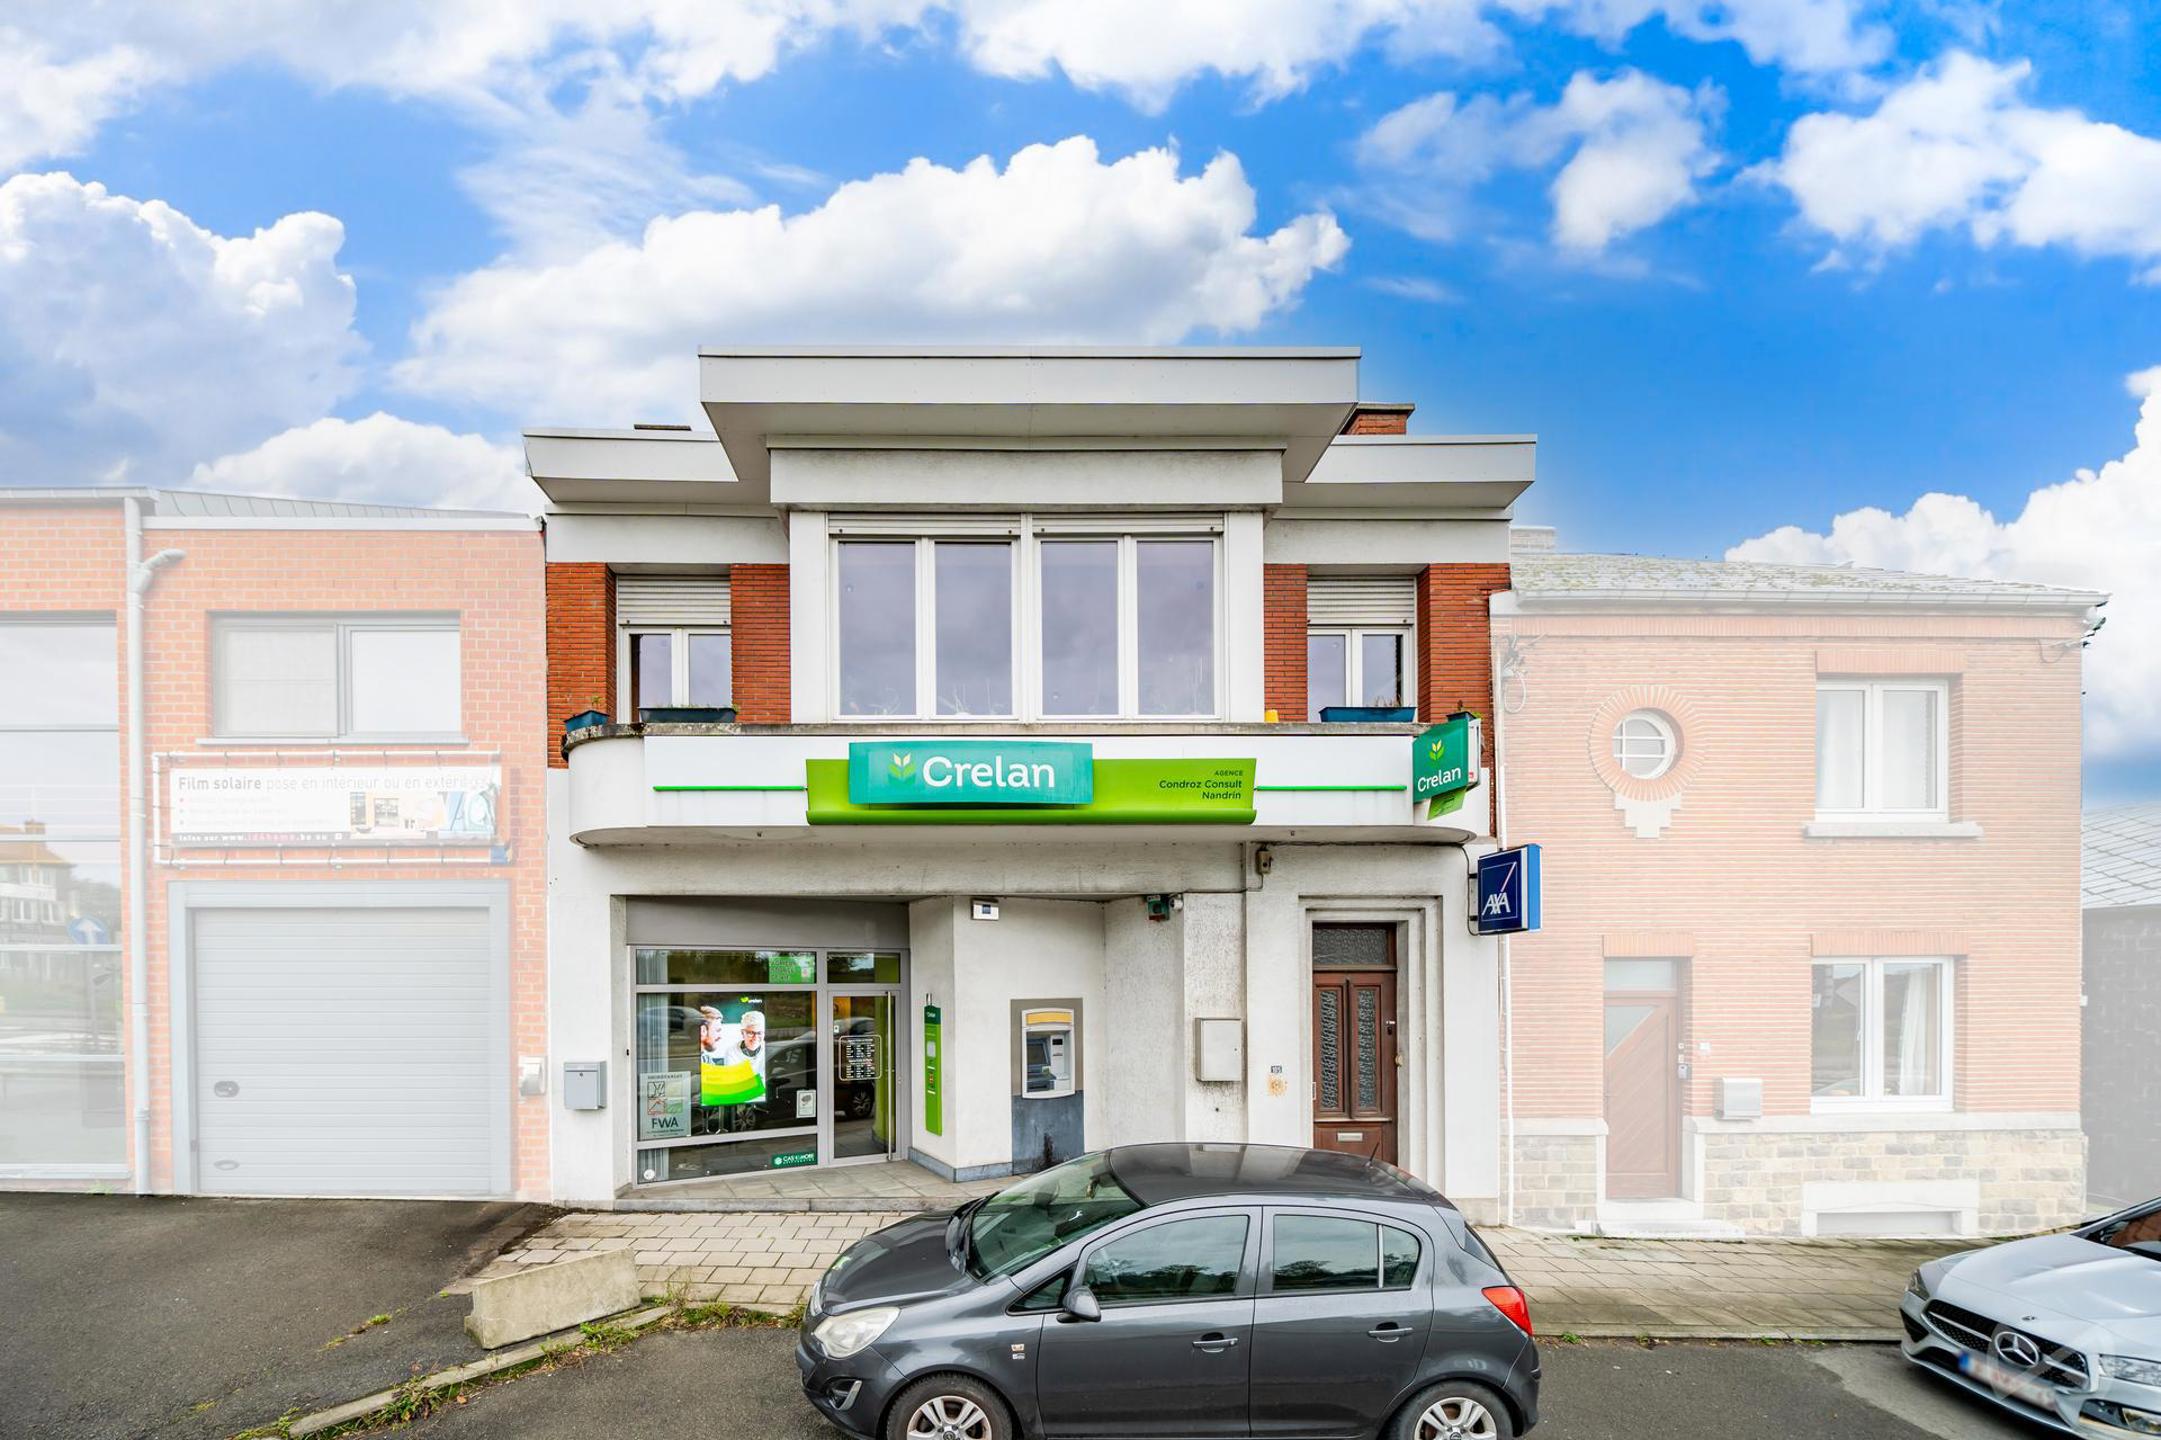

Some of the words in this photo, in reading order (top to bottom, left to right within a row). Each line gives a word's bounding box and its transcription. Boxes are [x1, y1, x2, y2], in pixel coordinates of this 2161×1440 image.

[922, 755, 1056, 788] Crelan
[1214, 769, 1244, 777] AGENCE
[178, 775, 209, 790] Film
[213, 775, 262, 790] solaire
[266, 778, 297, 793] pose
[301, 778, 318, 790] en
[384, 778, 401, 790] ou
[404, 778, 420, 790] en
[1159, 779, 1202, 789] Condroz
[1204, 779, 1243, 789] Consult
[1417, 766, 1462, 794] Crelan
[1202, 791, 1241, 800] Nandrin
[1481, 891, 1511, 916] AXA
[651, 1117, 679, 1129] FWA
